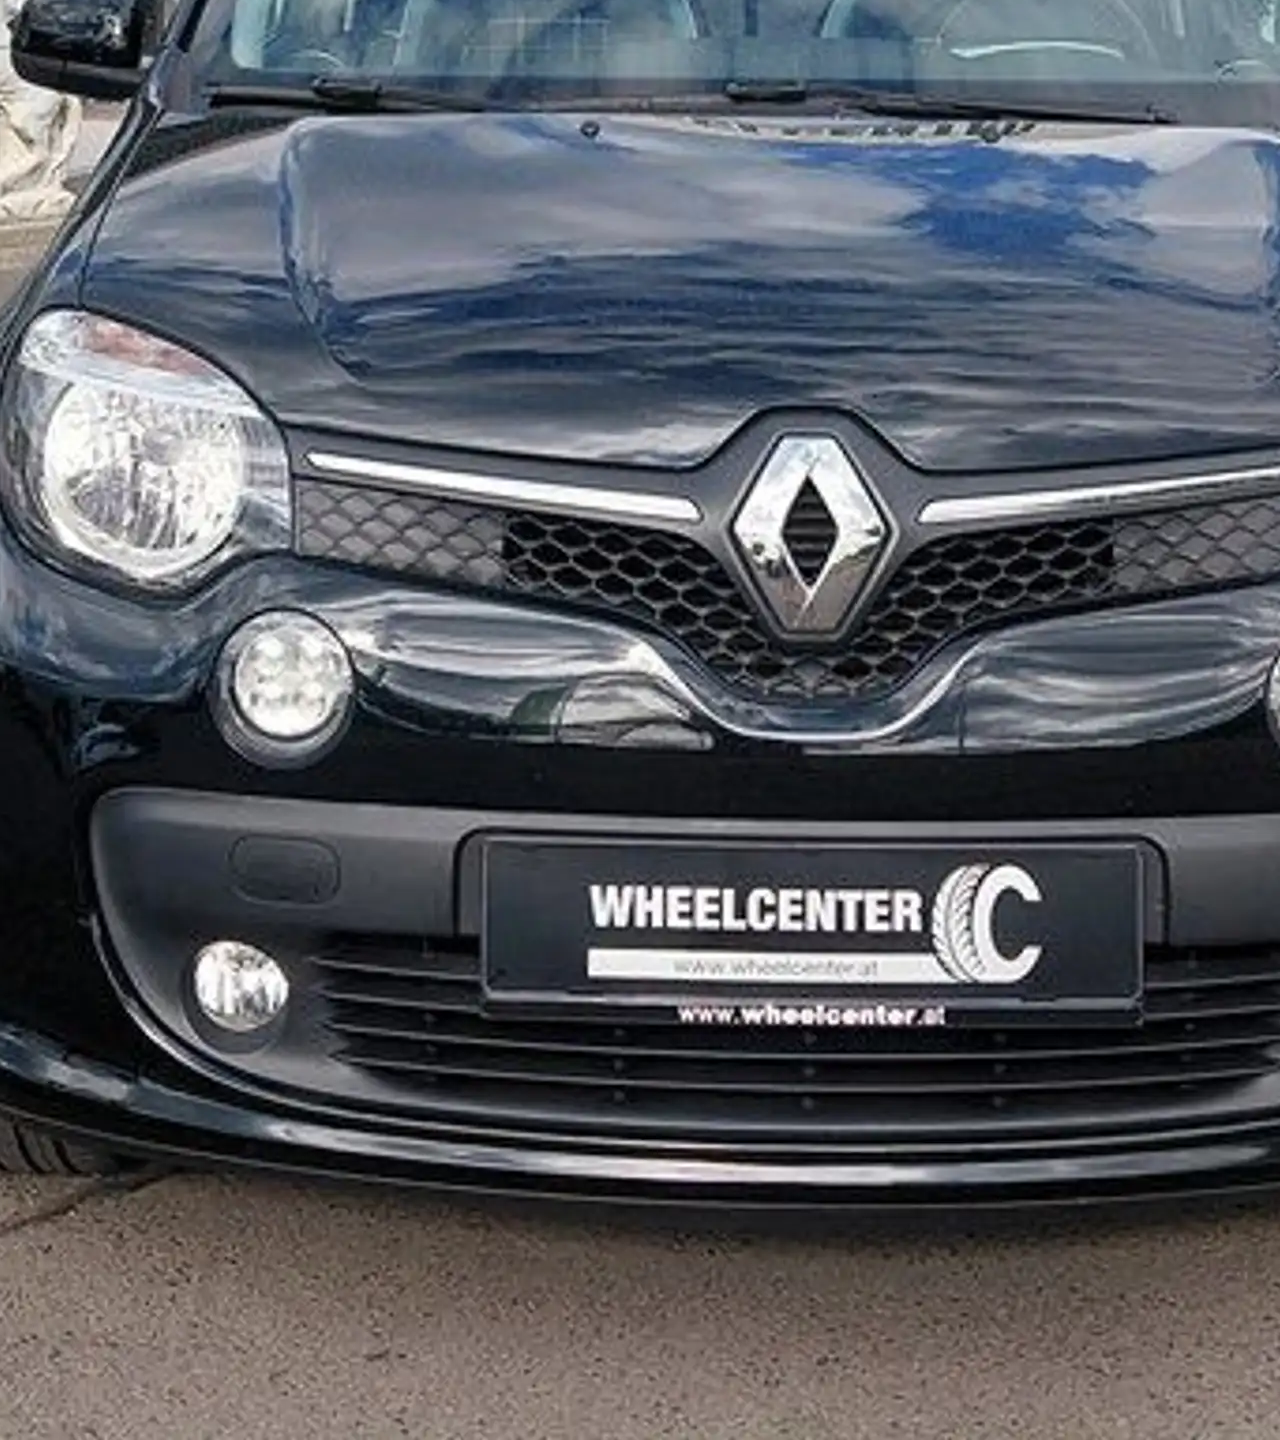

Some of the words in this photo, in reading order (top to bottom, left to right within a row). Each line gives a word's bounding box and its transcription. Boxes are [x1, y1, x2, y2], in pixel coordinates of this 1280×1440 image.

[588, 883, 923, 933] WHEELCENTER
[672, 956, 879, 978] www.wheelcenter.at
[677, 1002, 948, 1027] www.wheelcenter.at
